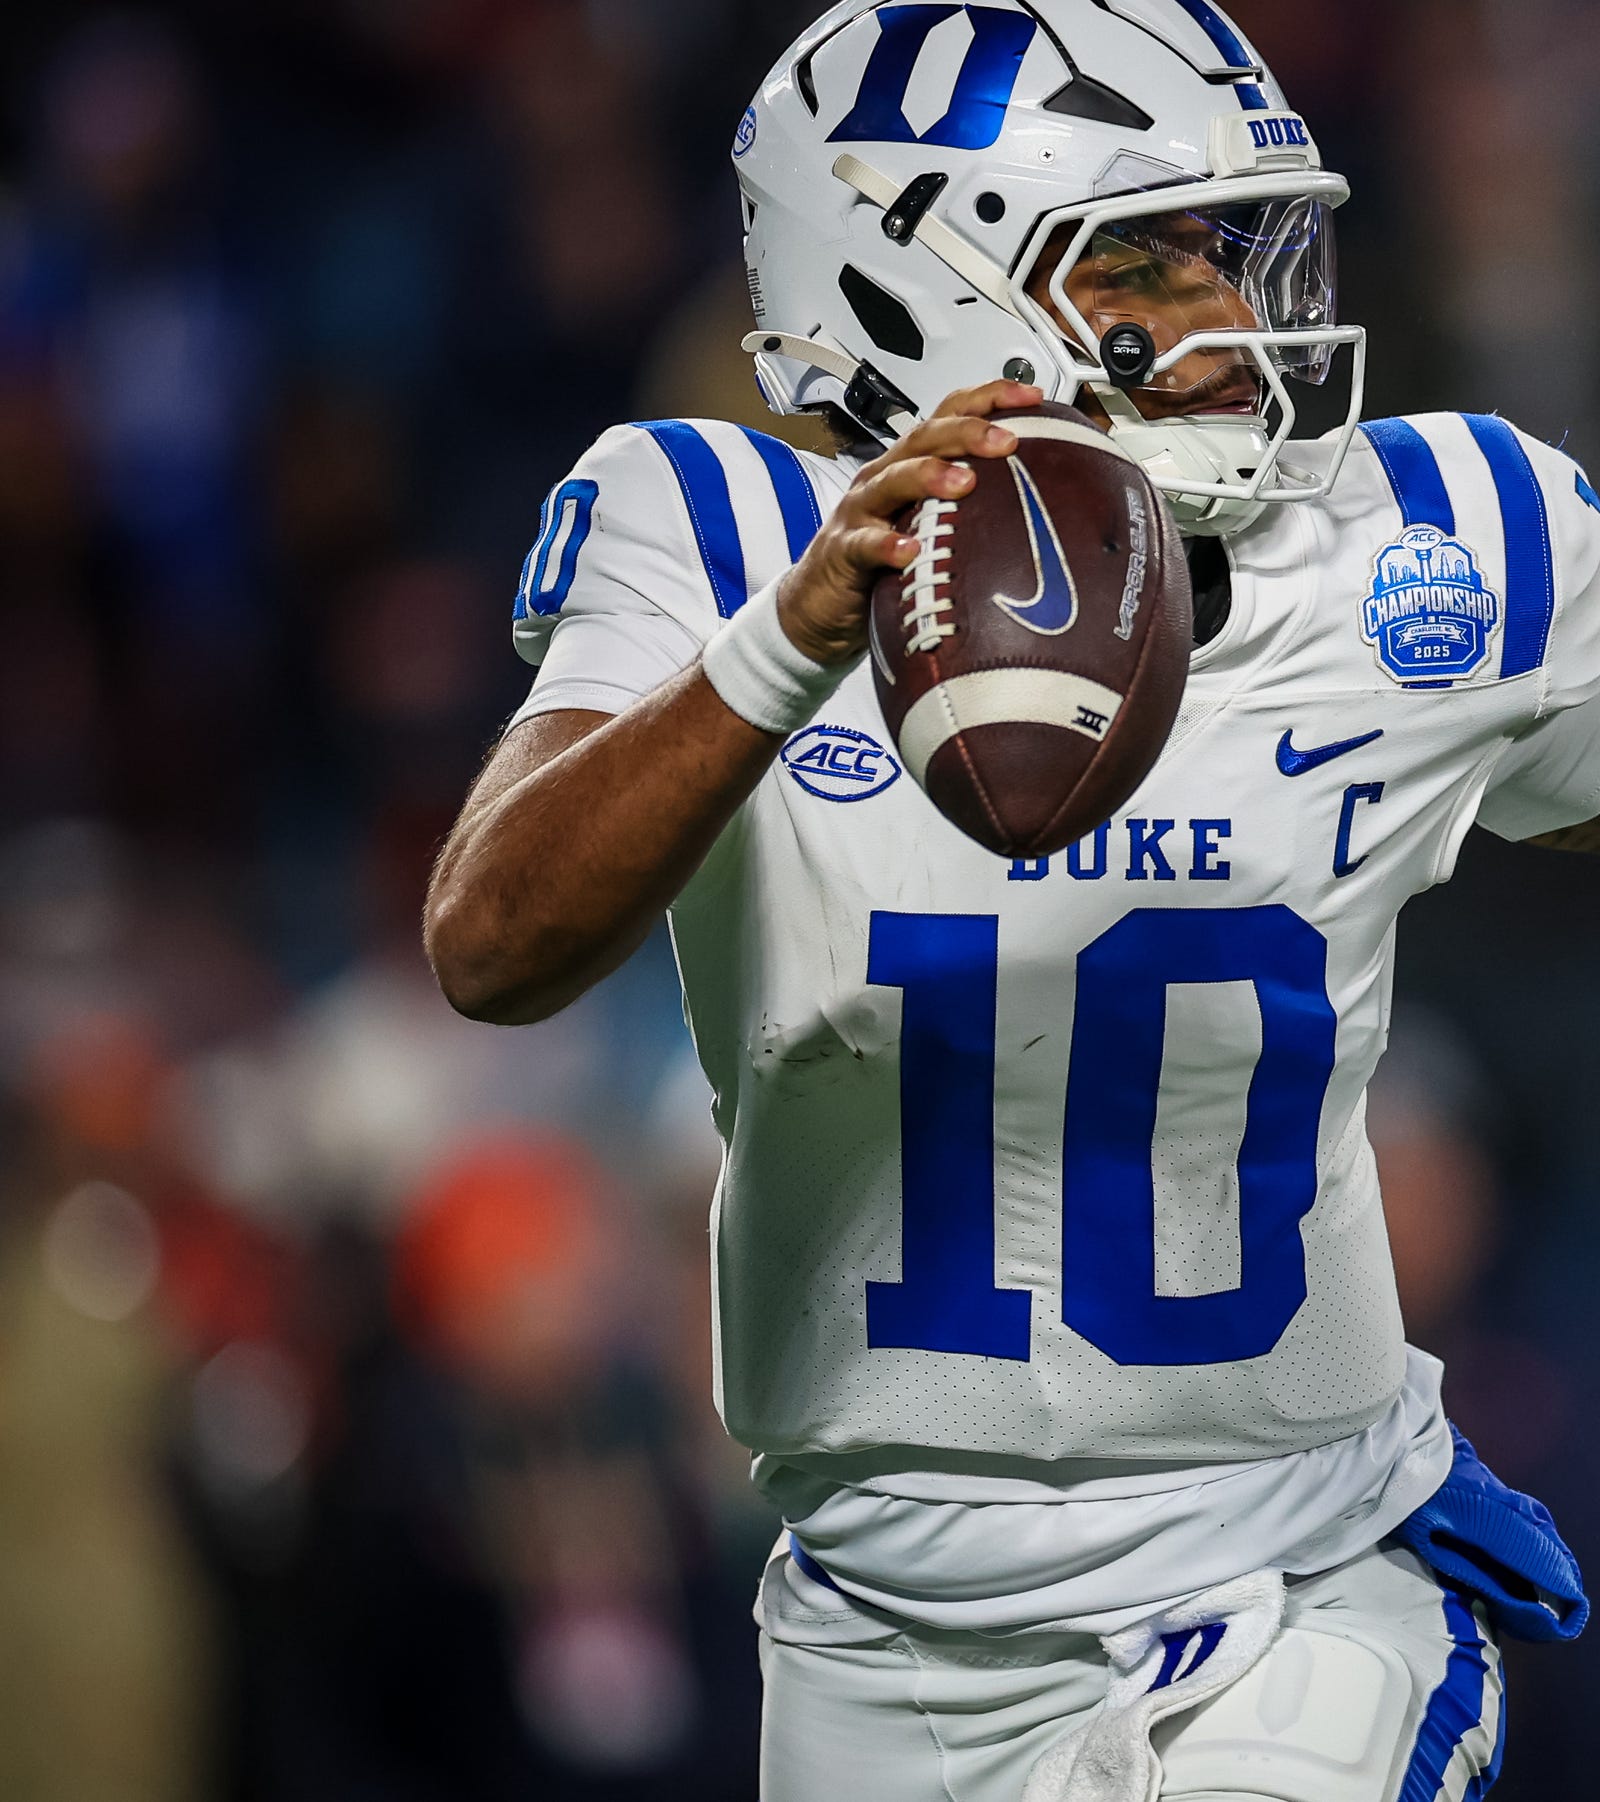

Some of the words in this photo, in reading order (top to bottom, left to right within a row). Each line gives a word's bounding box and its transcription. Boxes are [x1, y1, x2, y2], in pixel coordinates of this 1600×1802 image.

[1246, 117, 1309, 148] DUKE
[1407, 533, 1436, 543] ACC
[1366, 585, 1494, 635] CHAMPIONSHIP
[1414, 645, 1450, 659] 2025
[794, 742, 884, 776] ACC
[1333, 781, 1386, 878] C
[865, 903, 1338, 1366] 10
